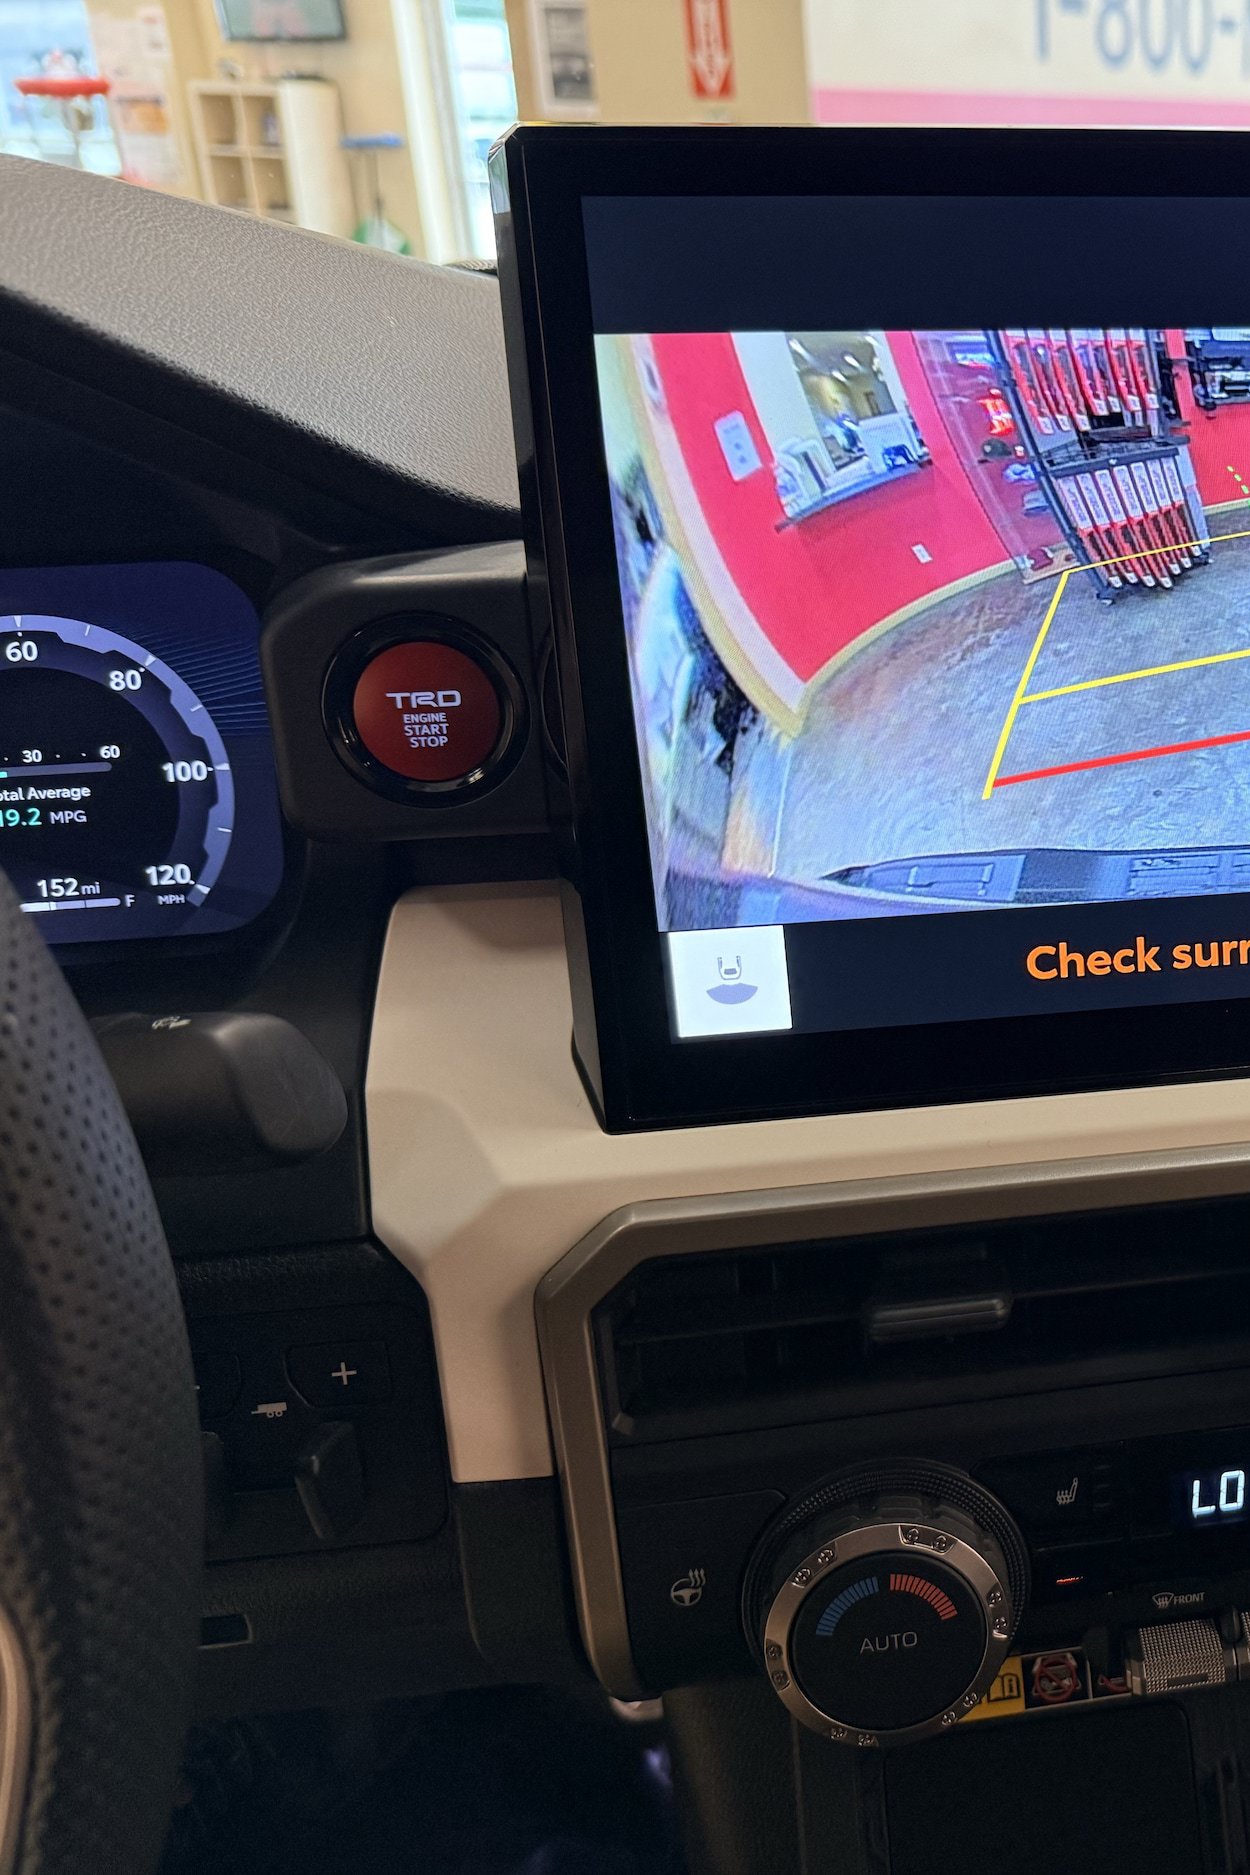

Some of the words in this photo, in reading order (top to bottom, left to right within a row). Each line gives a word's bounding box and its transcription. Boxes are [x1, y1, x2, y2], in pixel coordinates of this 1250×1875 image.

[5, 640, 39, 663] 60
[109, 669, 142, 691] 80
[385, 690, 462, 709] TRD
[403, 712, 448, 724] ENGINE
[404, 723, 449, 736] START
[410, 735, 449, 748] STOP
[22, 749, 43, 763] 30
[99, 744, 121, 759] 60
[162, 761, 208, 783] 100
[27, 786, 92, 801] Average
[50, 809, 88, 825] MPG
[146, 864, 192, 886] 120
[36, 877, 80, 898] 152
[81, 881, 101, 895] mi
[158, 893, 186, 905] MPH
[1026, 936, 1162, 980] Check
[1173, 1591, 1205, 1605] FRONT
[859, 1631, 918, 1655] AUTO
